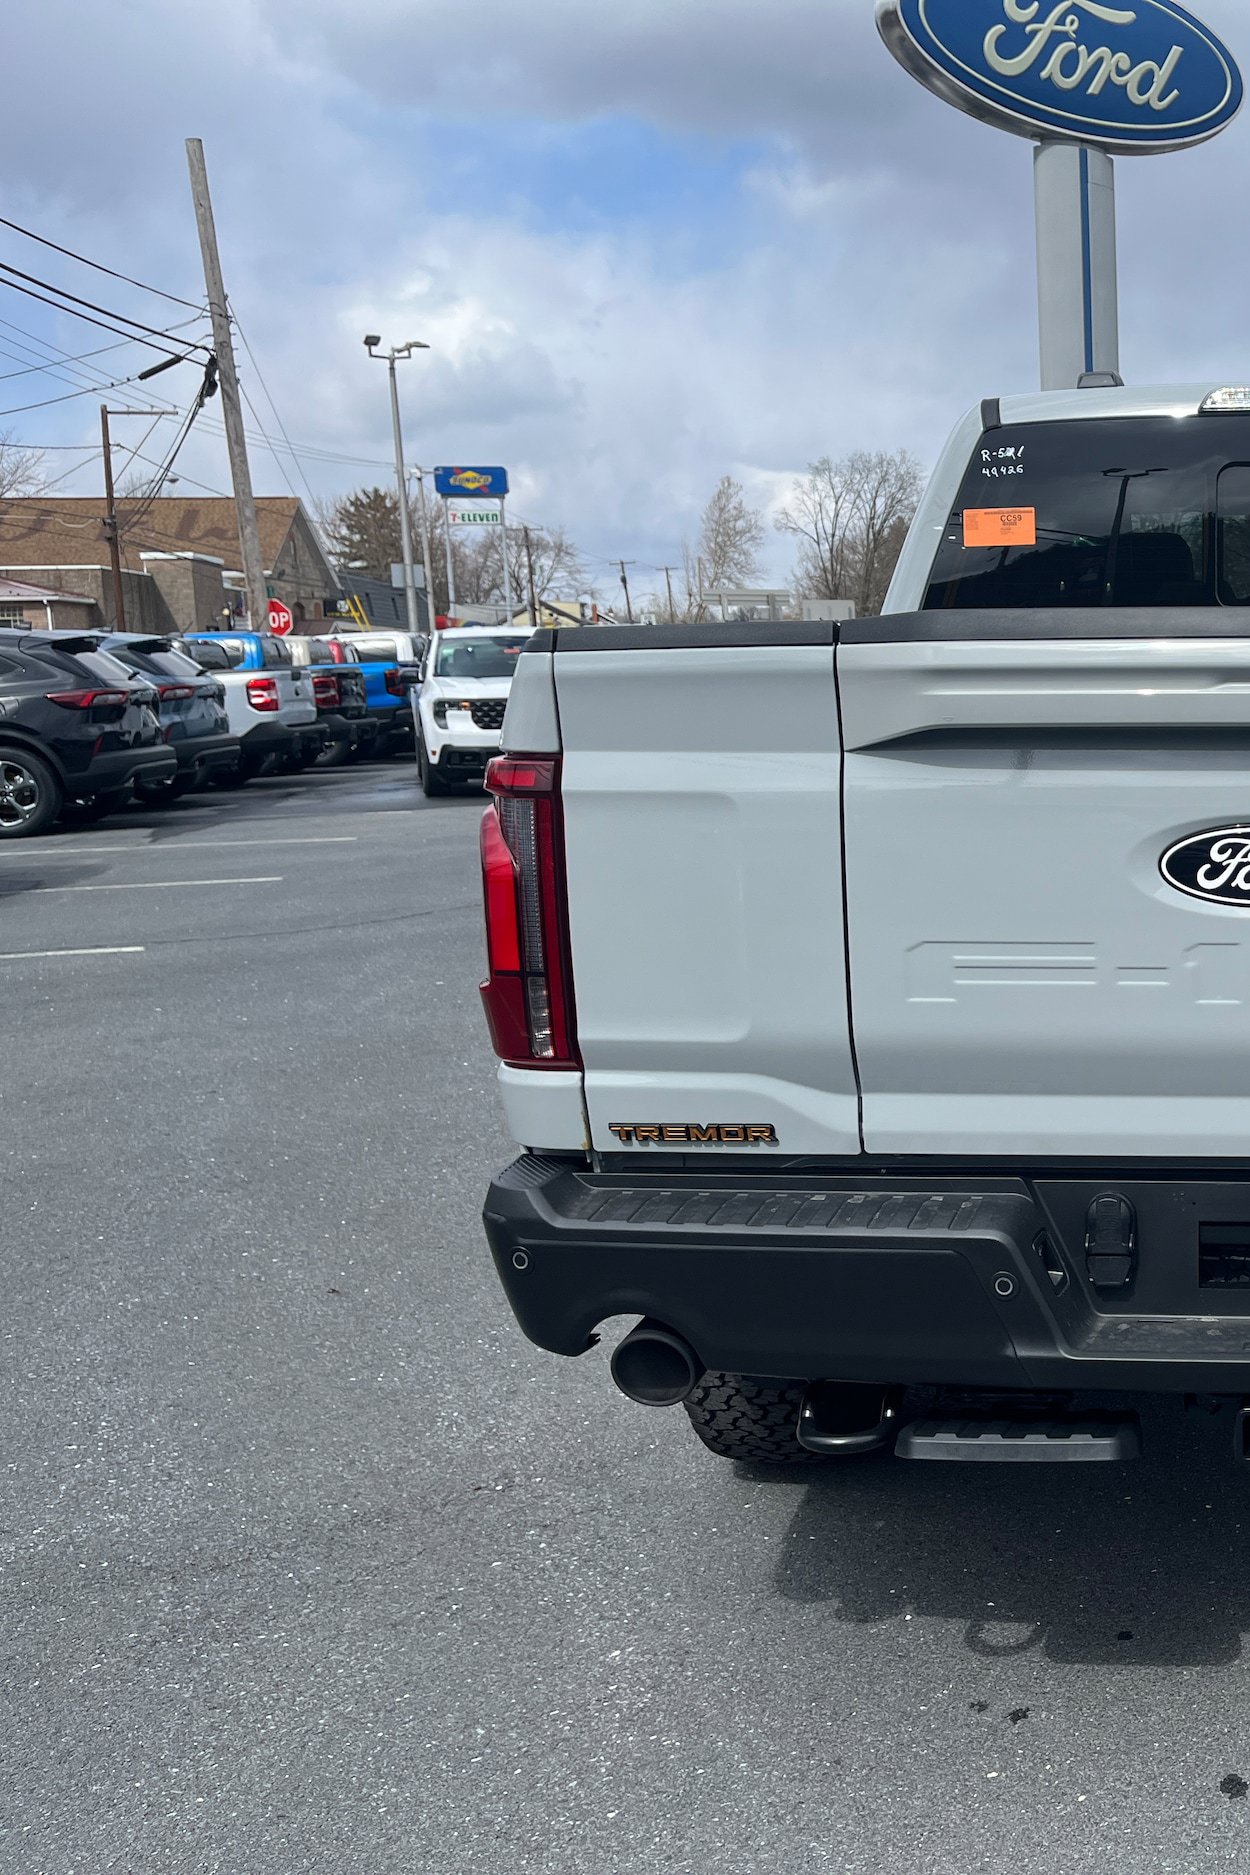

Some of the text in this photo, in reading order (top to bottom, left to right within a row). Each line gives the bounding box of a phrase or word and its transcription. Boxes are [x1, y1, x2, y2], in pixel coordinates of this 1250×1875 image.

[983, 0, 1183, 111] Ford
[268, 611, 289, 629] OP
[608, 1122, 779, 1142] TREMOR
